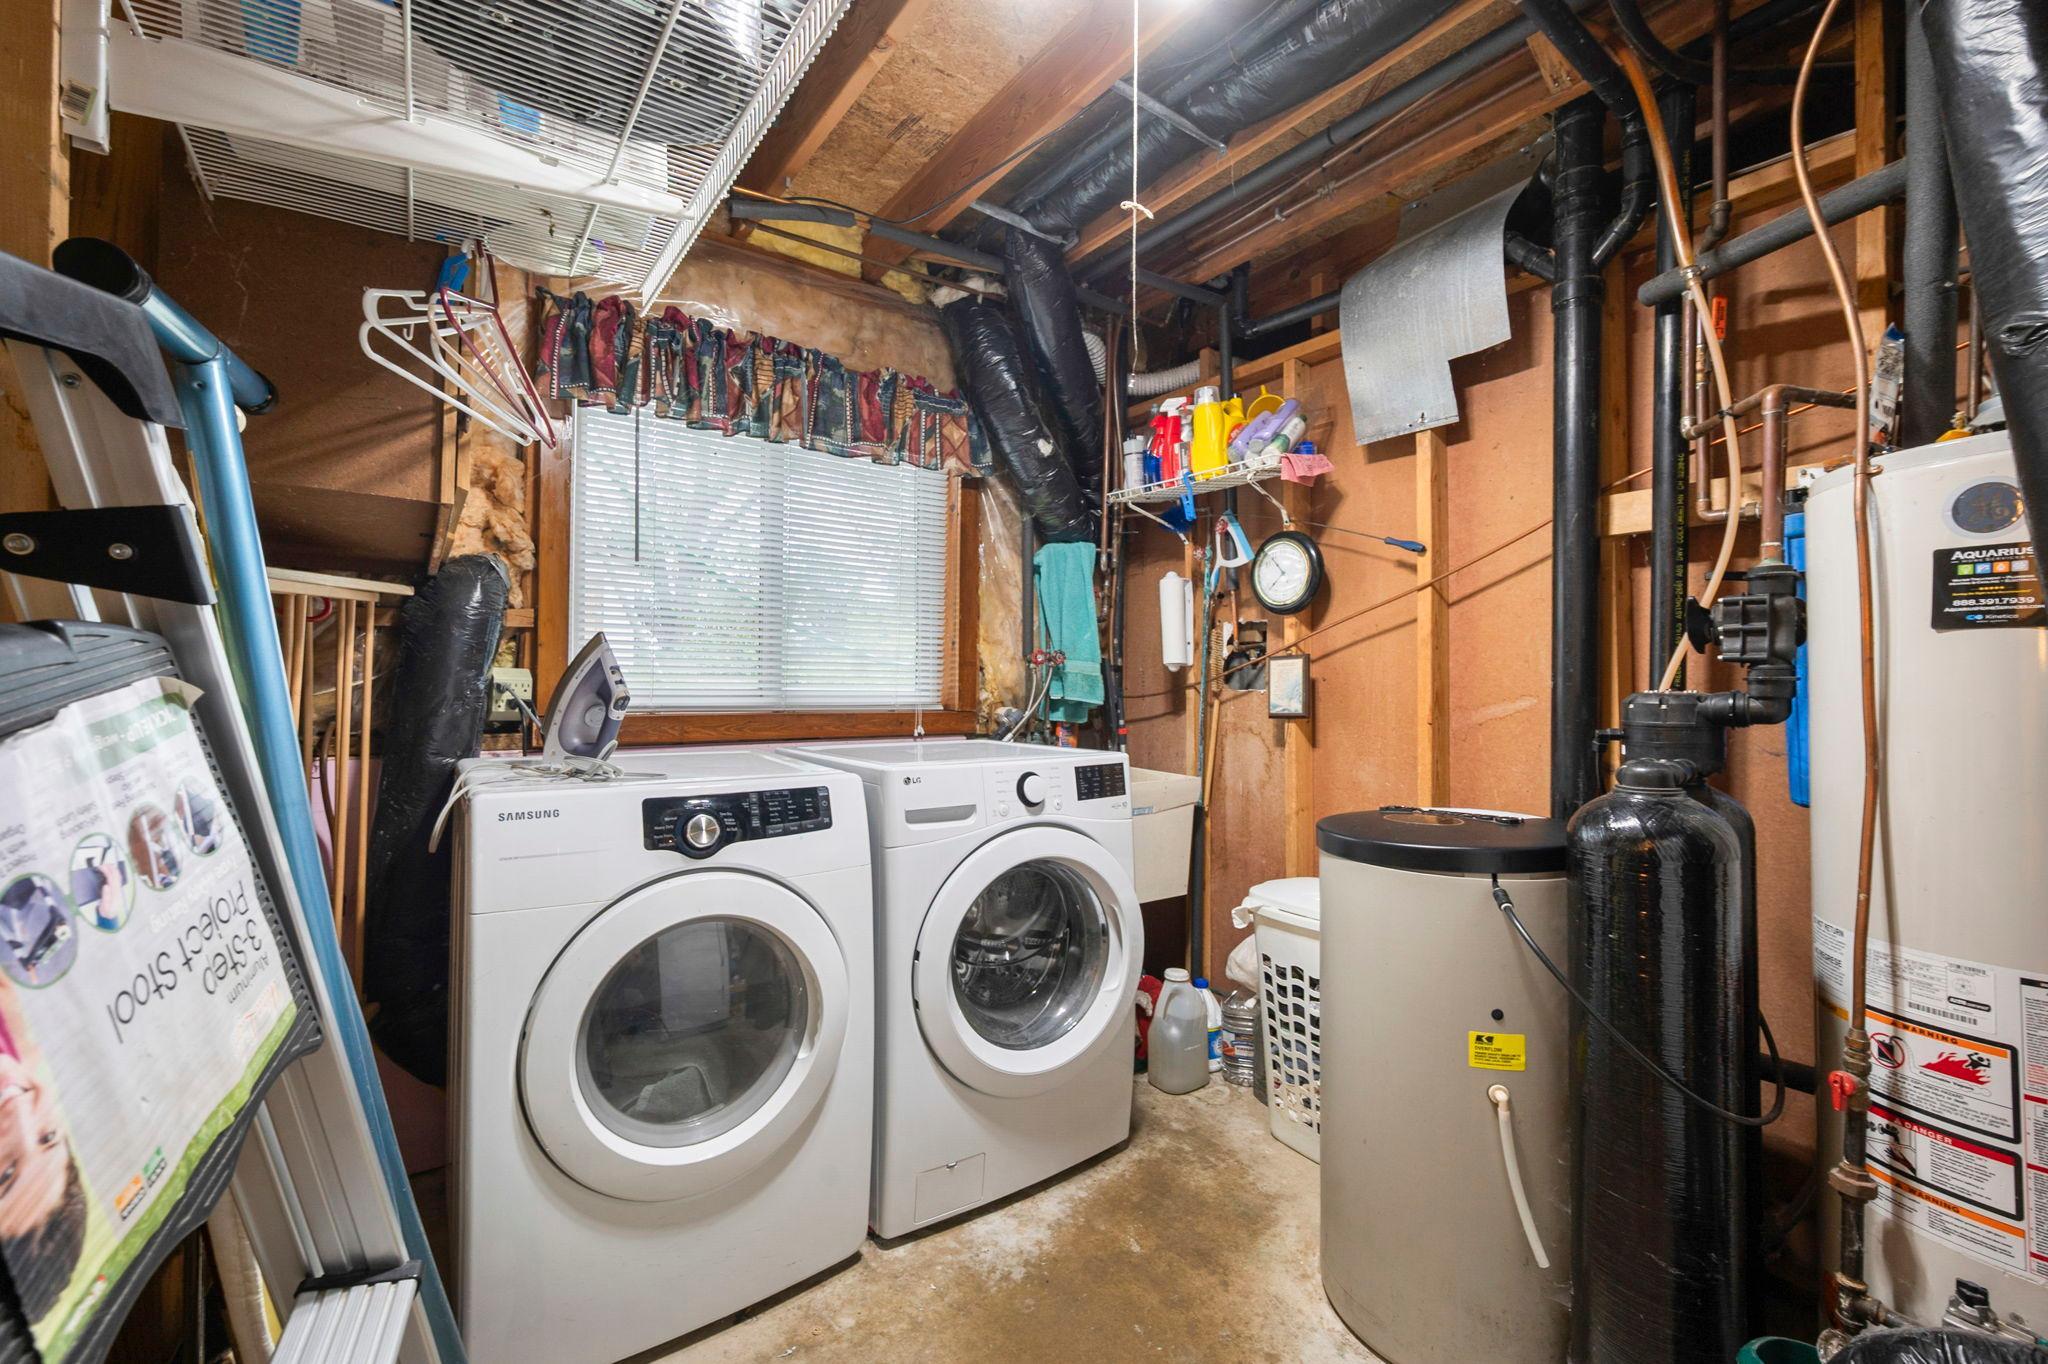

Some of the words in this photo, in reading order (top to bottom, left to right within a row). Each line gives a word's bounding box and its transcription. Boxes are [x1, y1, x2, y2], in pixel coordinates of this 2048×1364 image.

[1952, 597, 2036, 606] 888.391.7939
[498, 809, 560, 822] SAMSUNG
[178, 880, 249, 972] Project
[203, 919, 262, 995] 3-Step
[226, 953, 270, 1003] Aluminum
[107, 951, 177, 1044] Stool
[1901, 1022, 1958, 1045] WARNING
[1905, 1122, 1953, 1145] DANGER
[1906, 1185, 1960, 1214] WARNING
